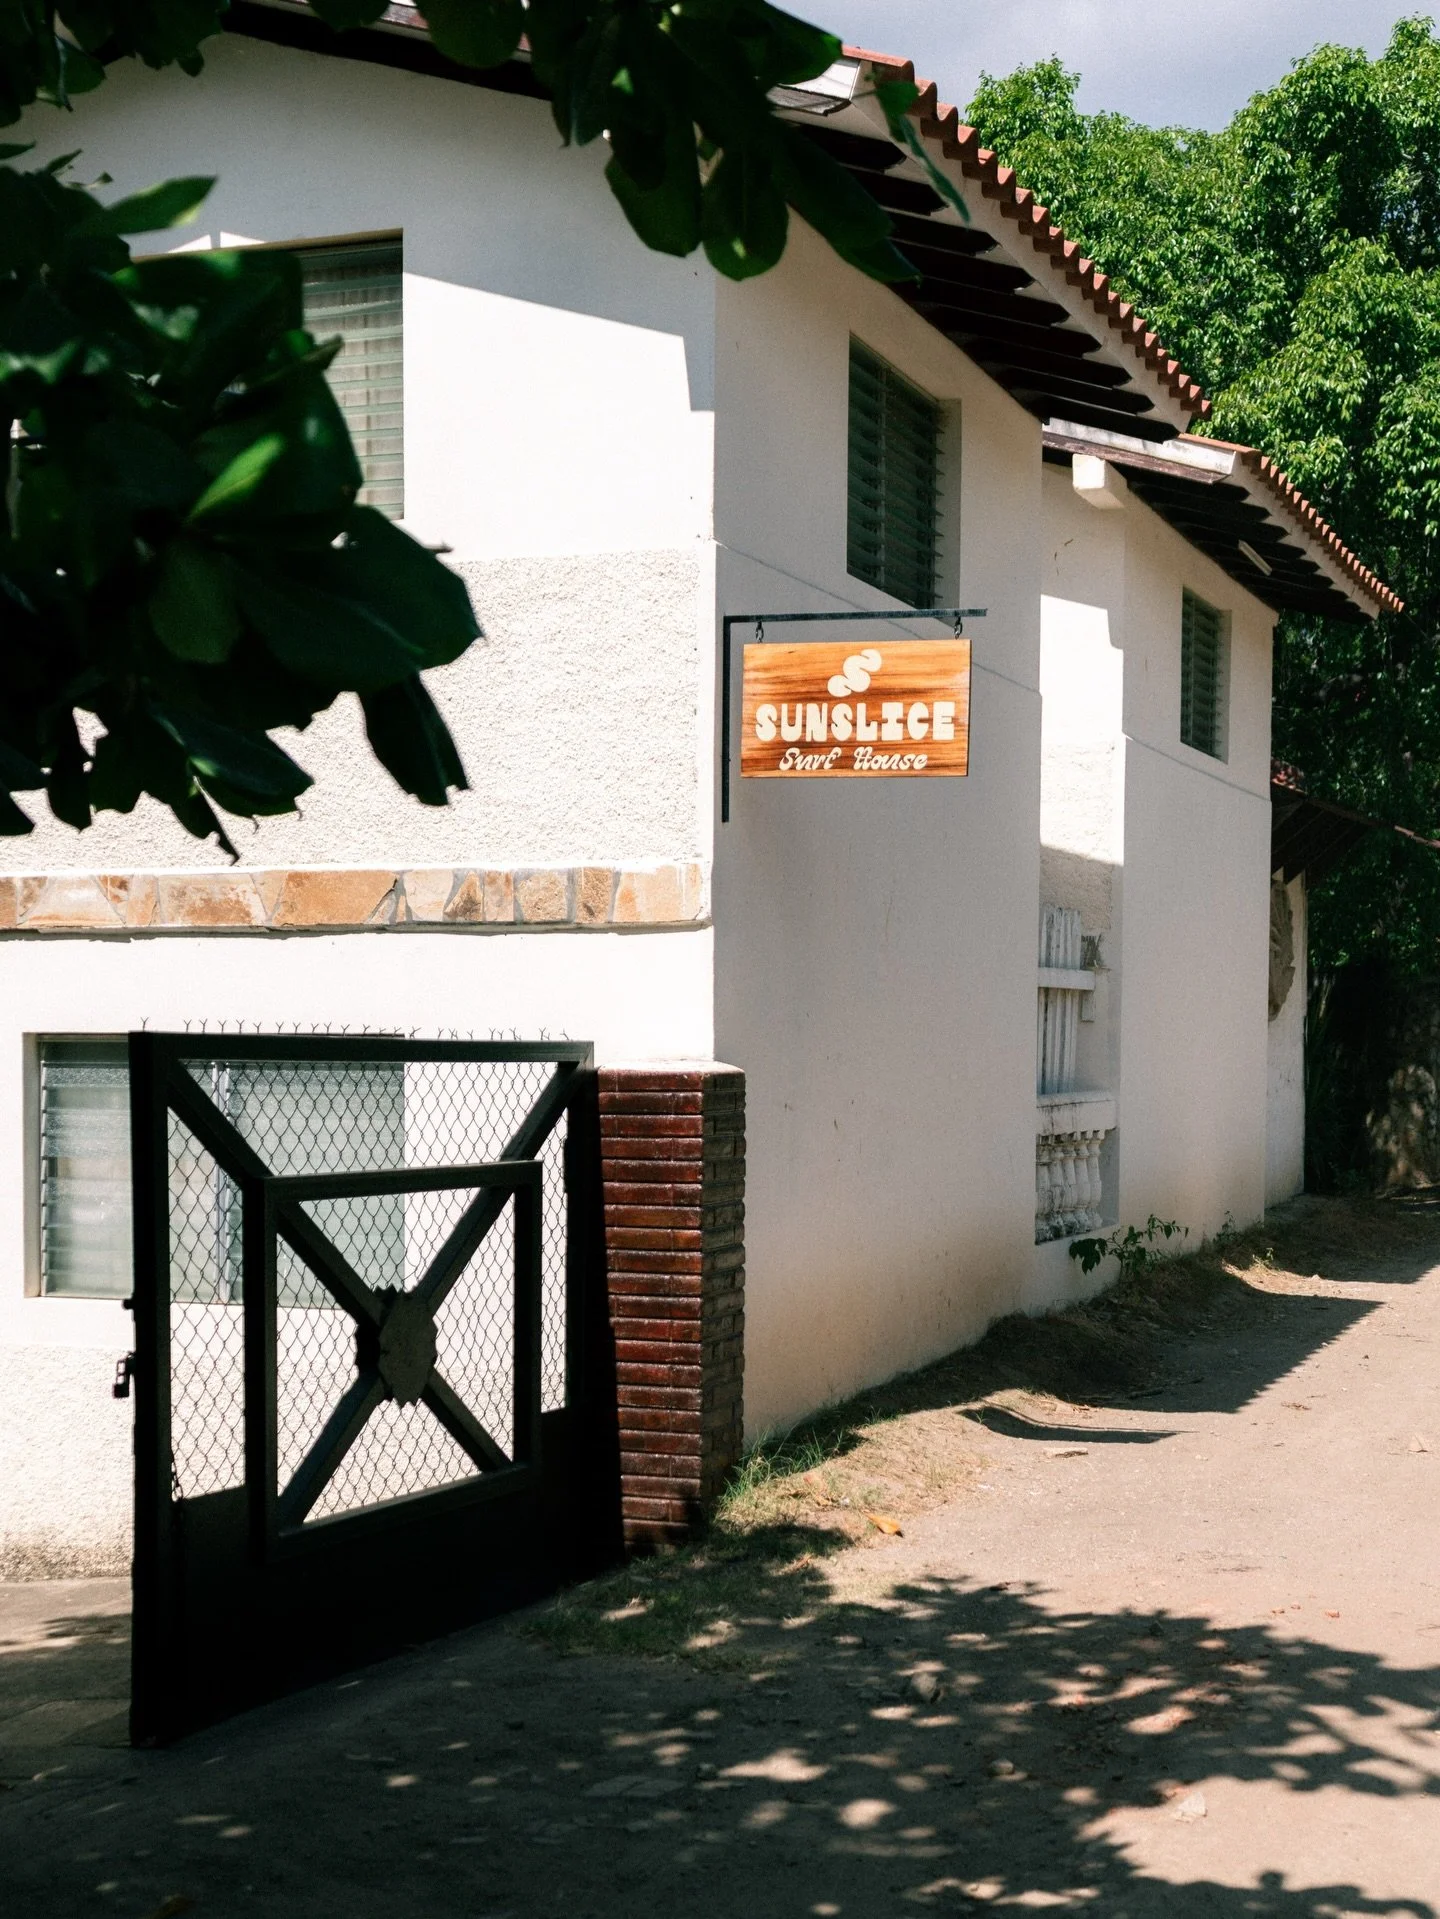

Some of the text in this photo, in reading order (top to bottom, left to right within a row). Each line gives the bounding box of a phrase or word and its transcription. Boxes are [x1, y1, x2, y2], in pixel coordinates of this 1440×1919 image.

[755, 701, 955, 742] SUNSLICE
[779, 746, 928, 771] Surf House
